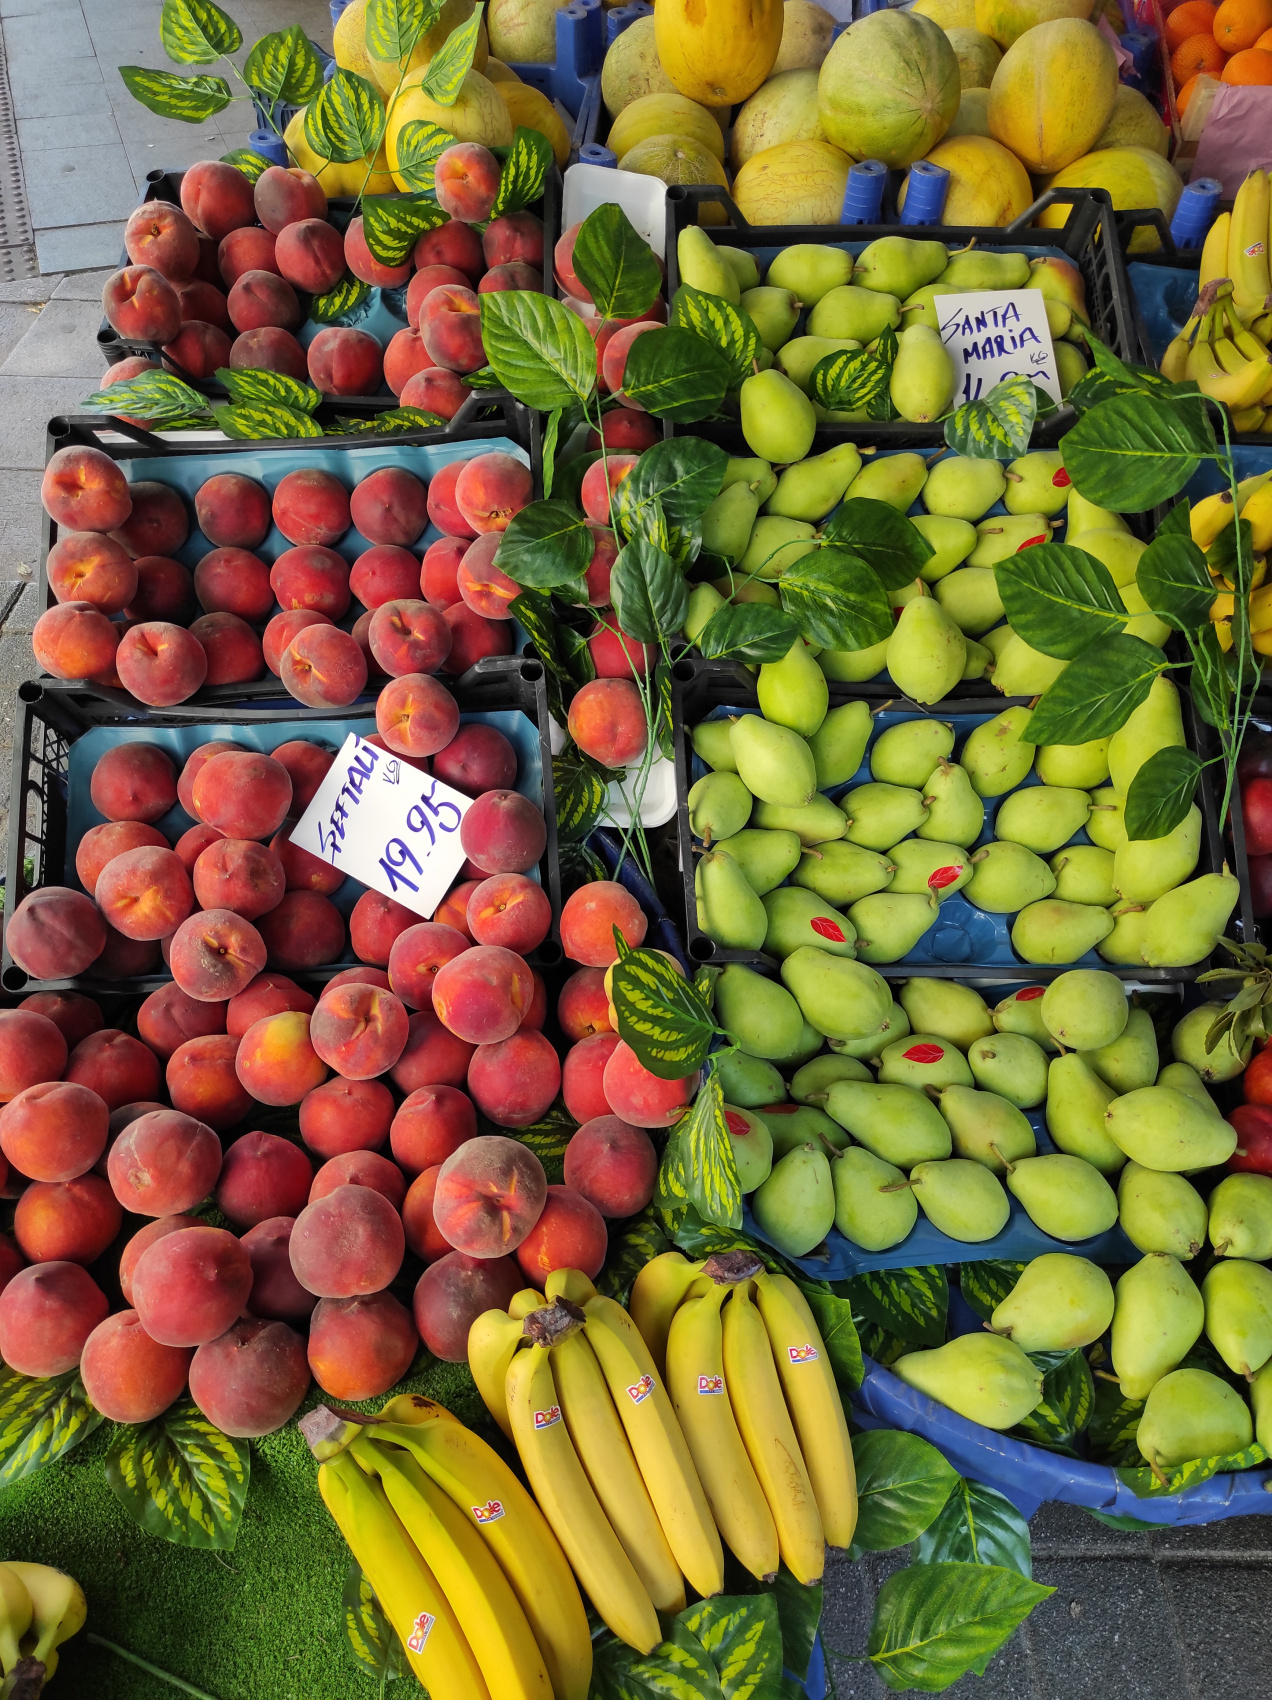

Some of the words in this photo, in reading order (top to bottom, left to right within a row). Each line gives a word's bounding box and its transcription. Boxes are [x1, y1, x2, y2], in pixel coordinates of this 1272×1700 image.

[941, 302, 1022, 344] SANTA
[378, 779, 462, 893] 19.95
[789, 1345, 816, 1358] Dole
[628, 1376, 652, 1399] Dole
[699, 1375, 722, 1390] Dole
[535, 1407, 559, 1424] Dole
[473, 1502, 501, 1518] Dole
[408, 1614, 429, 1650] Dole
